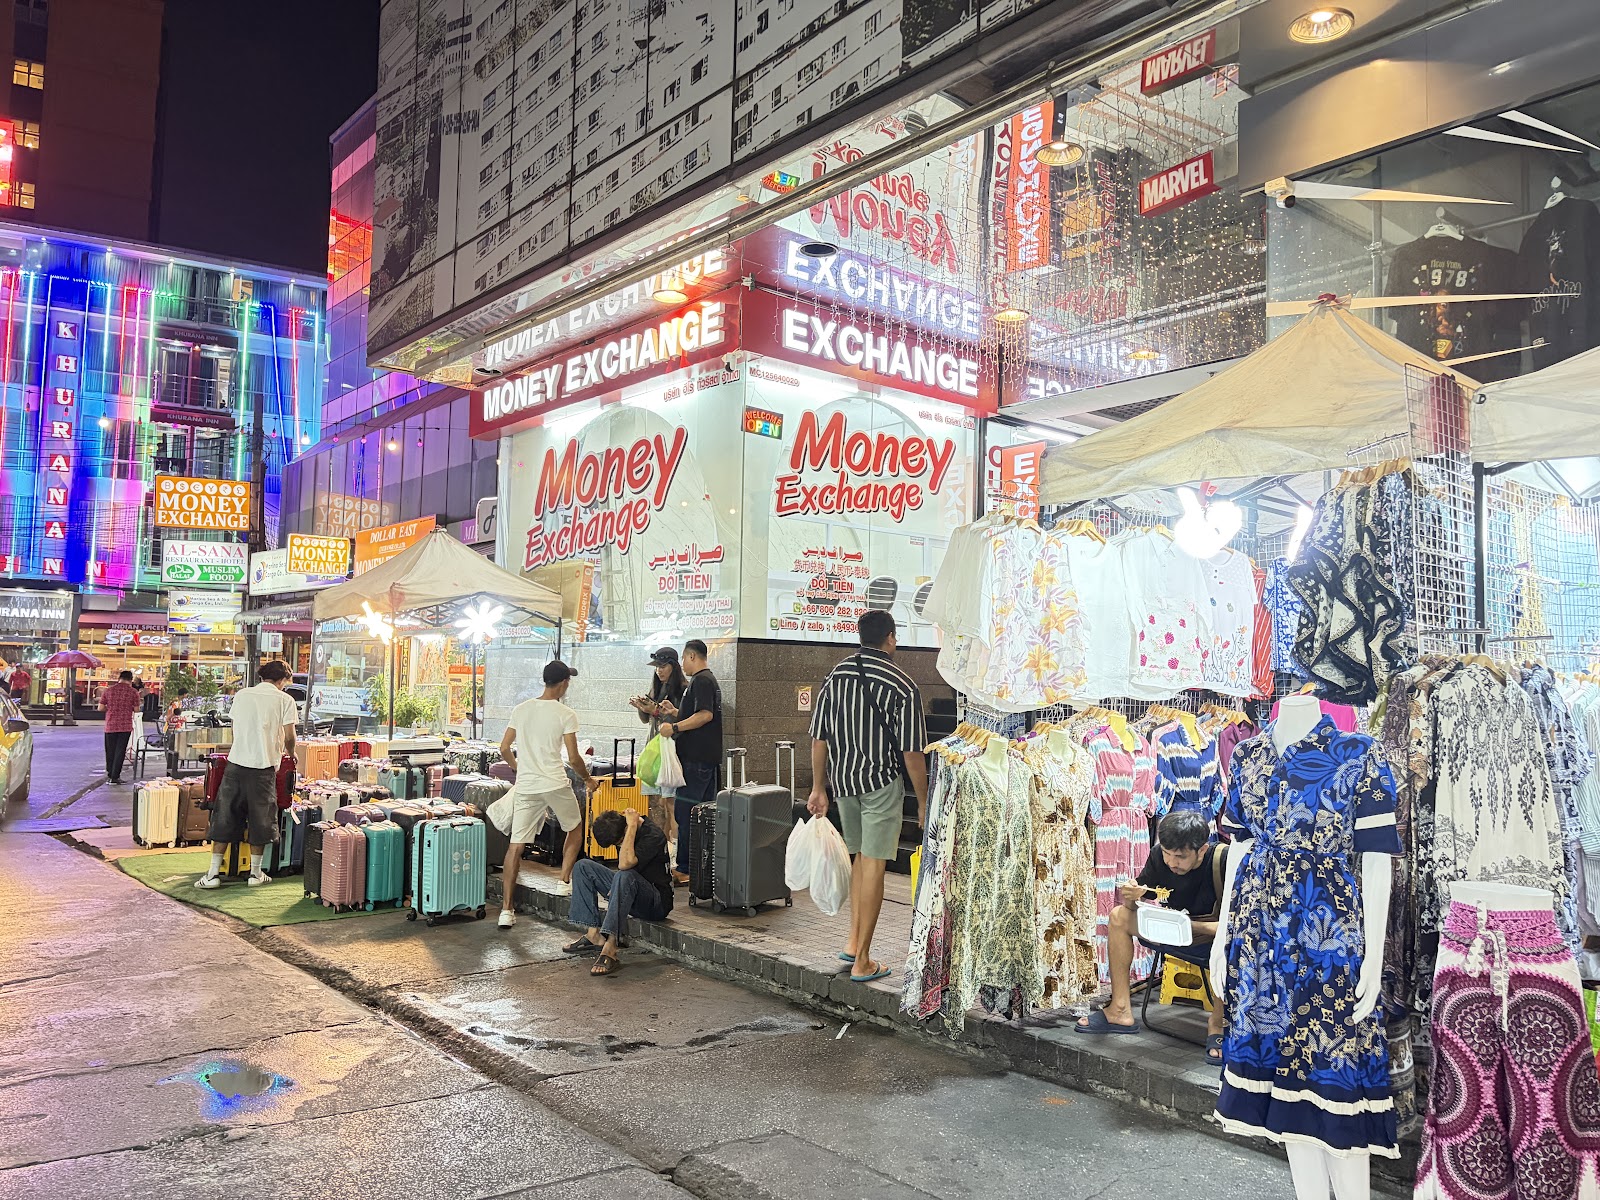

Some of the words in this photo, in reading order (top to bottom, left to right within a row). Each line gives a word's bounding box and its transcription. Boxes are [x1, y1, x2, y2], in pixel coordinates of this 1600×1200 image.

[1143, 158, 1209, 211] MARVEL
[783, 308, 979, 397] EXCHANGE
[483, 364, 560, 422] MONEY
[566, 301, 722, 393] EXCHANGE
[167, 413, 203, 423] KHURANA
[745, 410, 783, 427] WELCOME
[746, 419, 779, 437] OPEN
[789, 409, 956, 494] Money
[534, 425, 688, 520] Money
[159, 492, 247, 514] MONEY
[775, 470, 923, 523] Exchange
[157, 510, 249, 528] EXCHANGE
[370, 528, 397, 544] DOLLAR
[399, 523, 418, 538] EAST
[524, 497, 650, 571] Exchange
[166, 544, 245, 559] AL-SANA
[291, 546, 347, 563] MONEY
[203, 566, 239, 574] MUSLIM
[291, 560, 346, 575] EXCHANGE
[0, 607, 40, 618] RANA
[42, 609, 66, 619] INN
[802, 604, 816, 614] +66
[820, 605, 834, 615] 806
[837, 606, 851, 615] 282
[720, 615, 734, 625] 829
[780, 619, 797, 629] Line
[807, 621, 823, 630] zalo
[498, 627, 531, 637] C125640020
